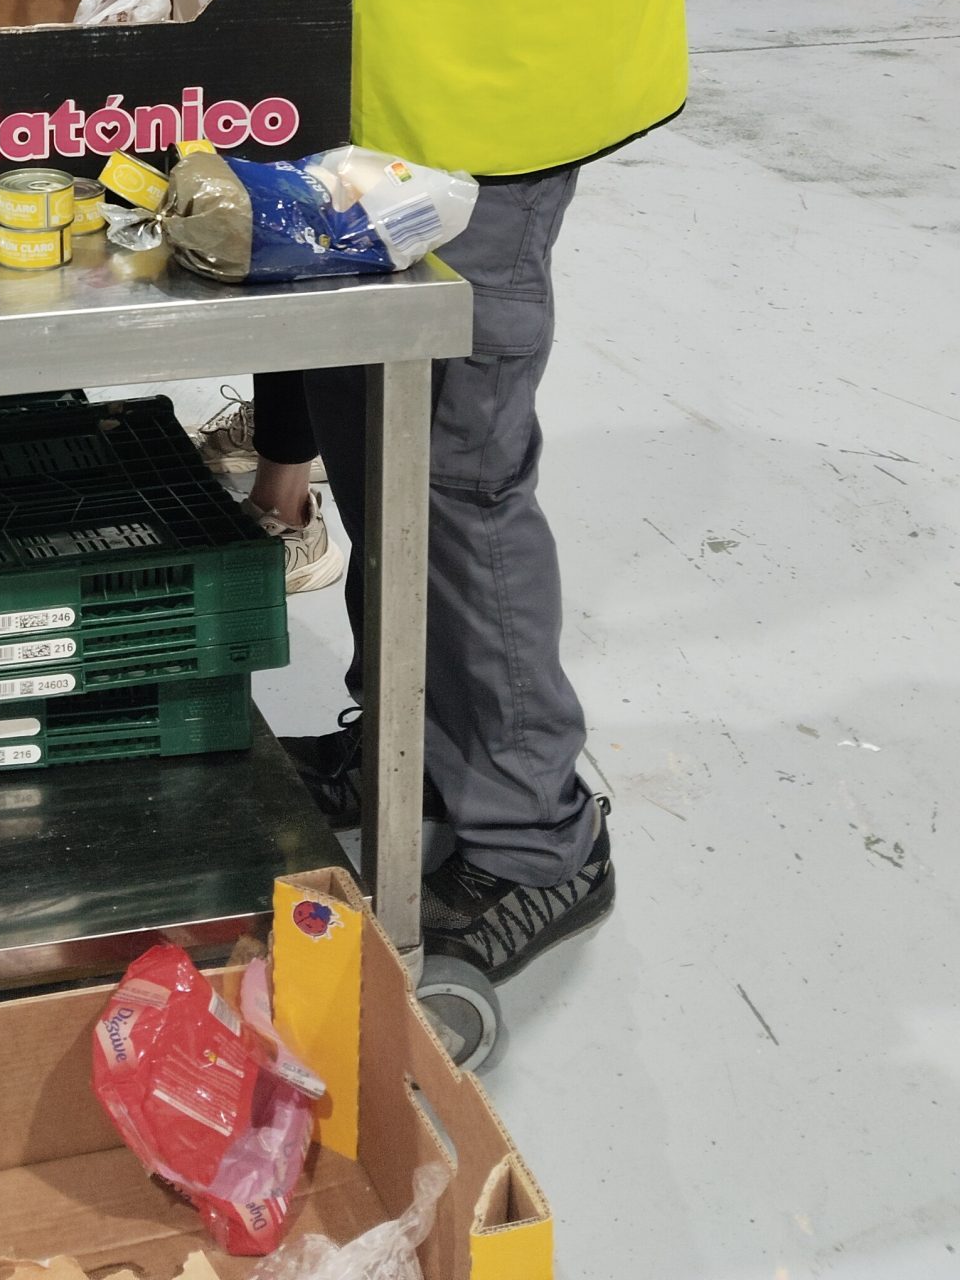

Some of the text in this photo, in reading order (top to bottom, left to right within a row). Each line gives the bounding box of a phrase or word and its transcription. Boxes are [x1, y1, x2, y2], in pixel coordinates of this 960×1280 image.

[21, 242, 54, 253] CLARO
[51, 612, 71, 623] 246
[54, 642, 73, 653] 216
[38, 679, 69, 691] 24603
[13, 750, 32, 760] 216
